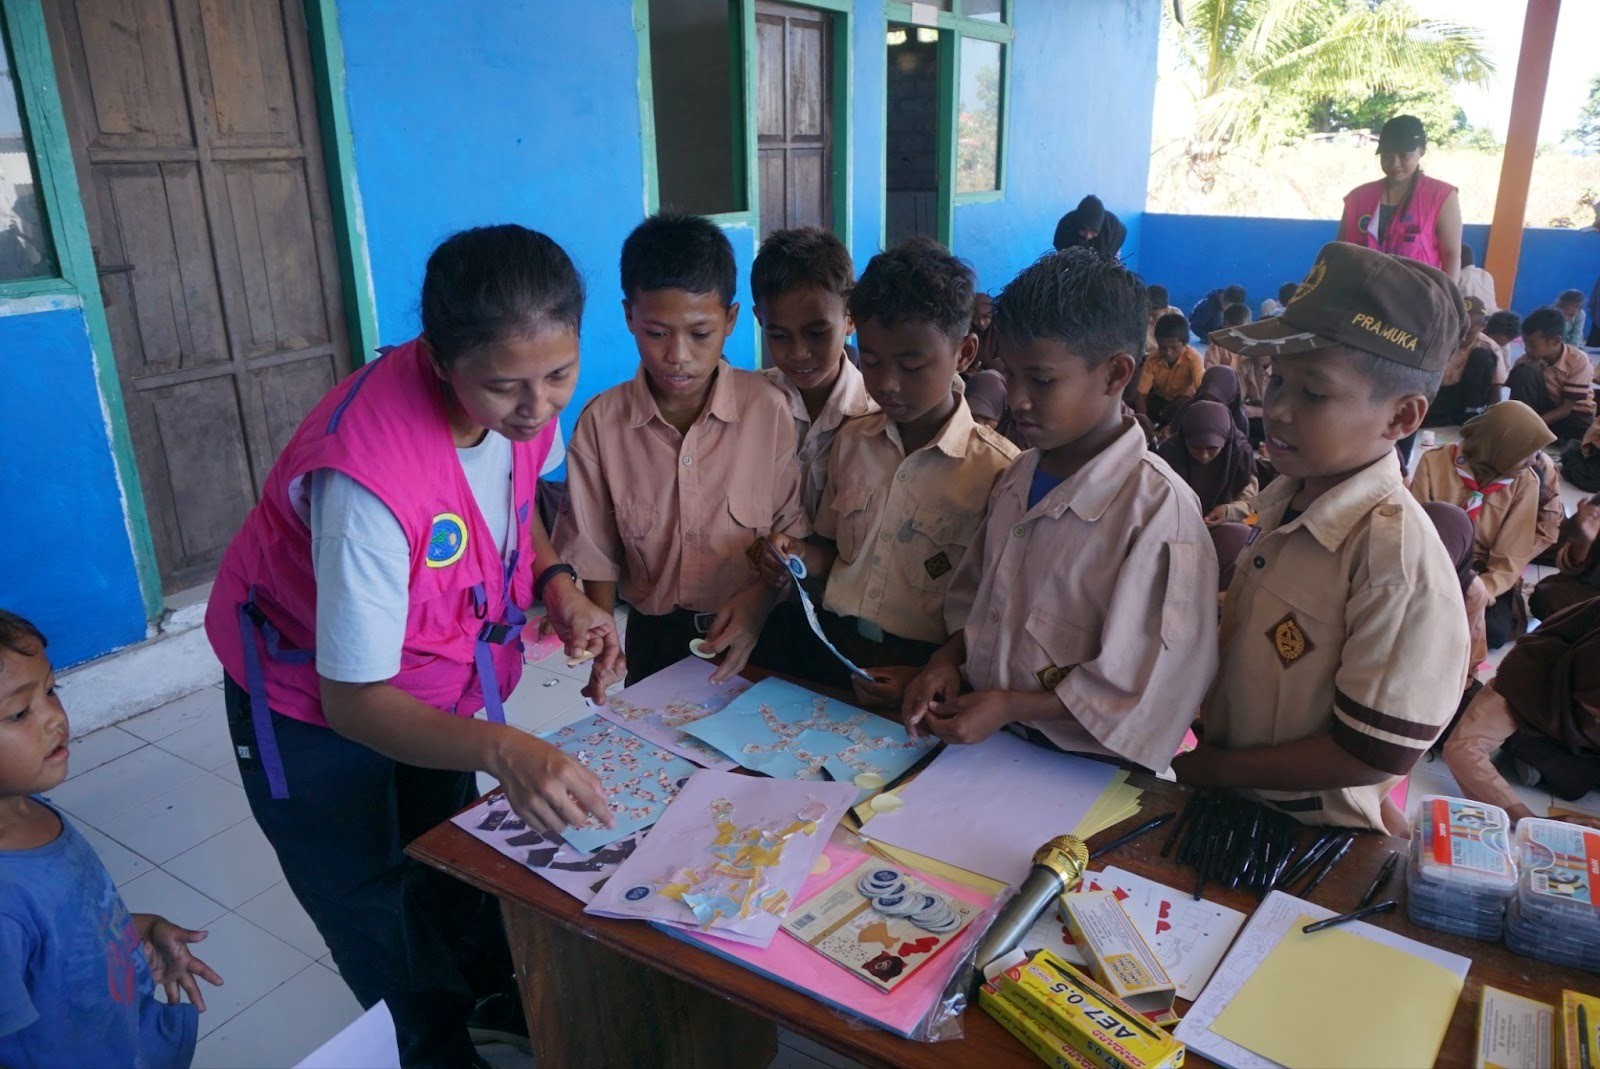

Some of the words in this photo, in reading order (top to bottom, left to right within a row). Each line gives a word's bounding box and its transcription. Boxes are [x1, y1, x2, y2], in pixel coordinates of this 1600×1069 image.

[1352, 313, 1419, 351] PRAMUKA
[1050, 983, 1084, 1004] 0.5
[1084, 1010, 1137, 1038] AE7
[1092, 1029, 1146, 1067] STANDARD
